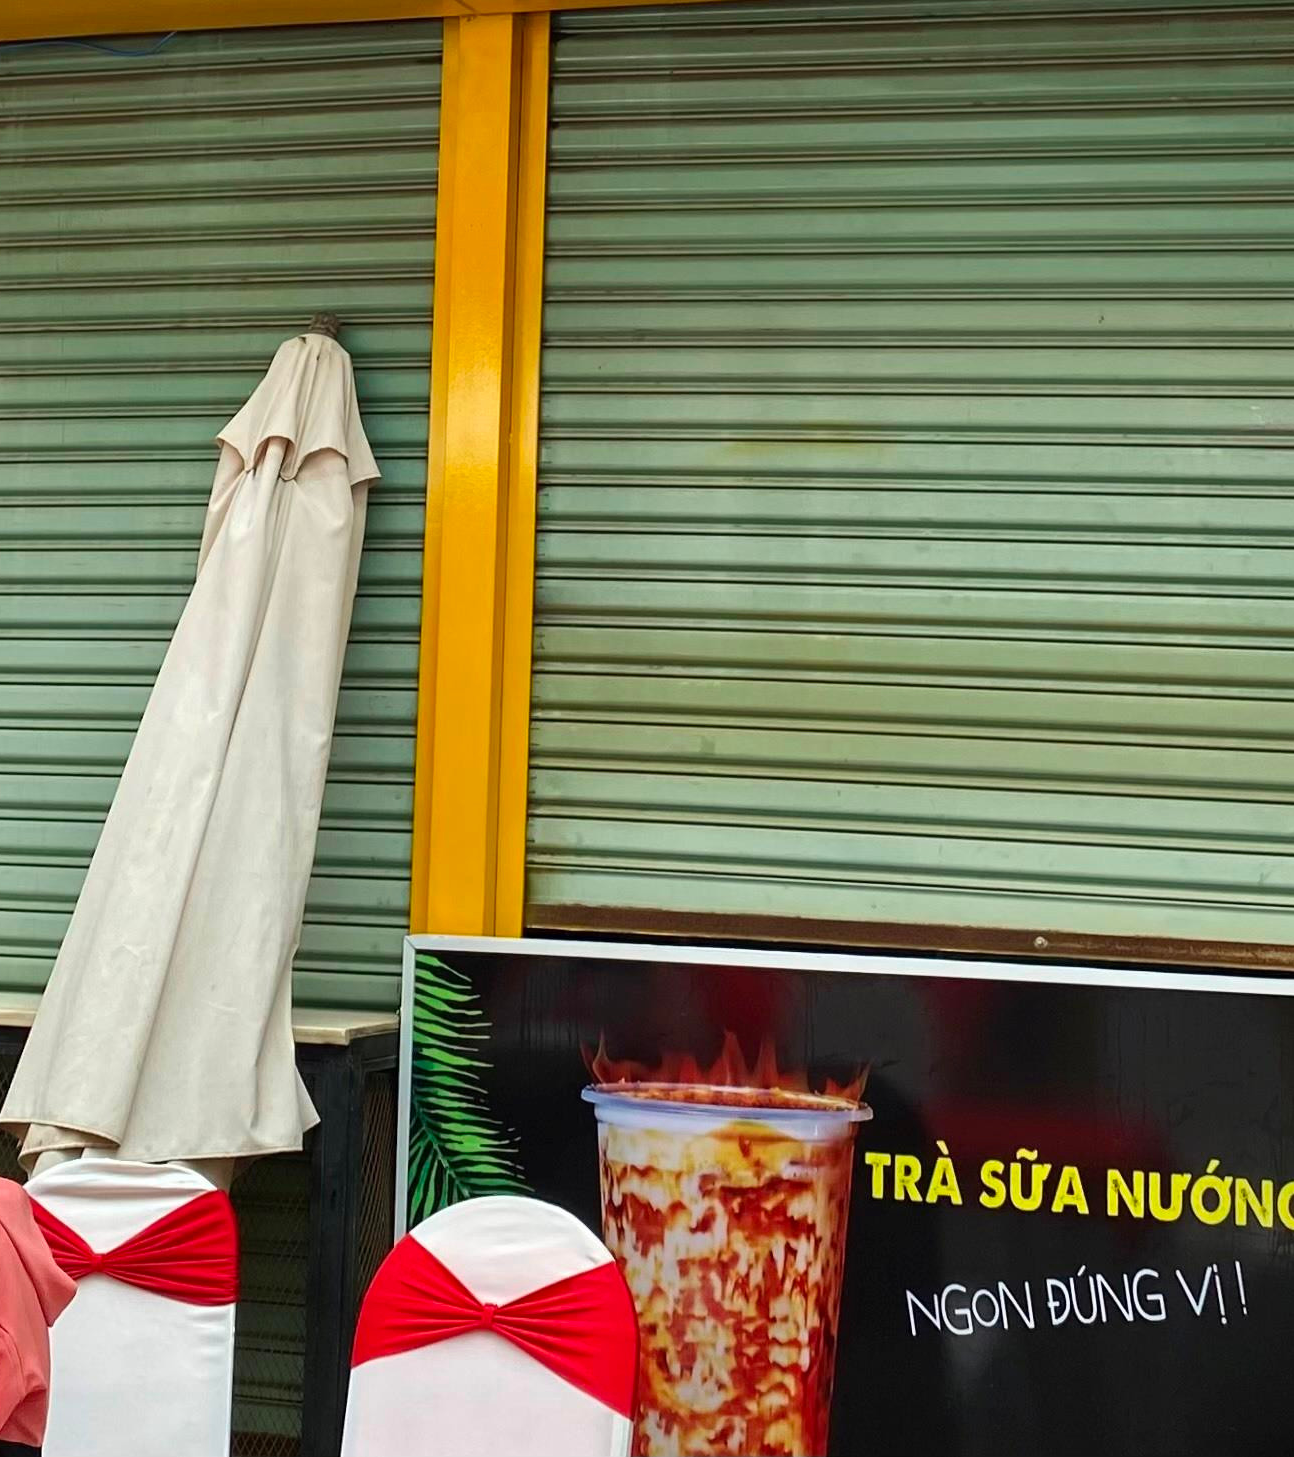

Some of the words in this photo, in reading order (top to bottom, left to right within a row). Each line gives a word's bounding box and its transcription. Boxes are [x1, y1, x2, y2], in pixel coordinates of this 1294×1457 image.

[863, 1140, 962, 1205] TRÀ
[978, 1148, 1089, 1215] SỮA
[905, 1281, 1035, 1337] NGON
[1046, 1264, 1167, 1326] ĐÚNG
